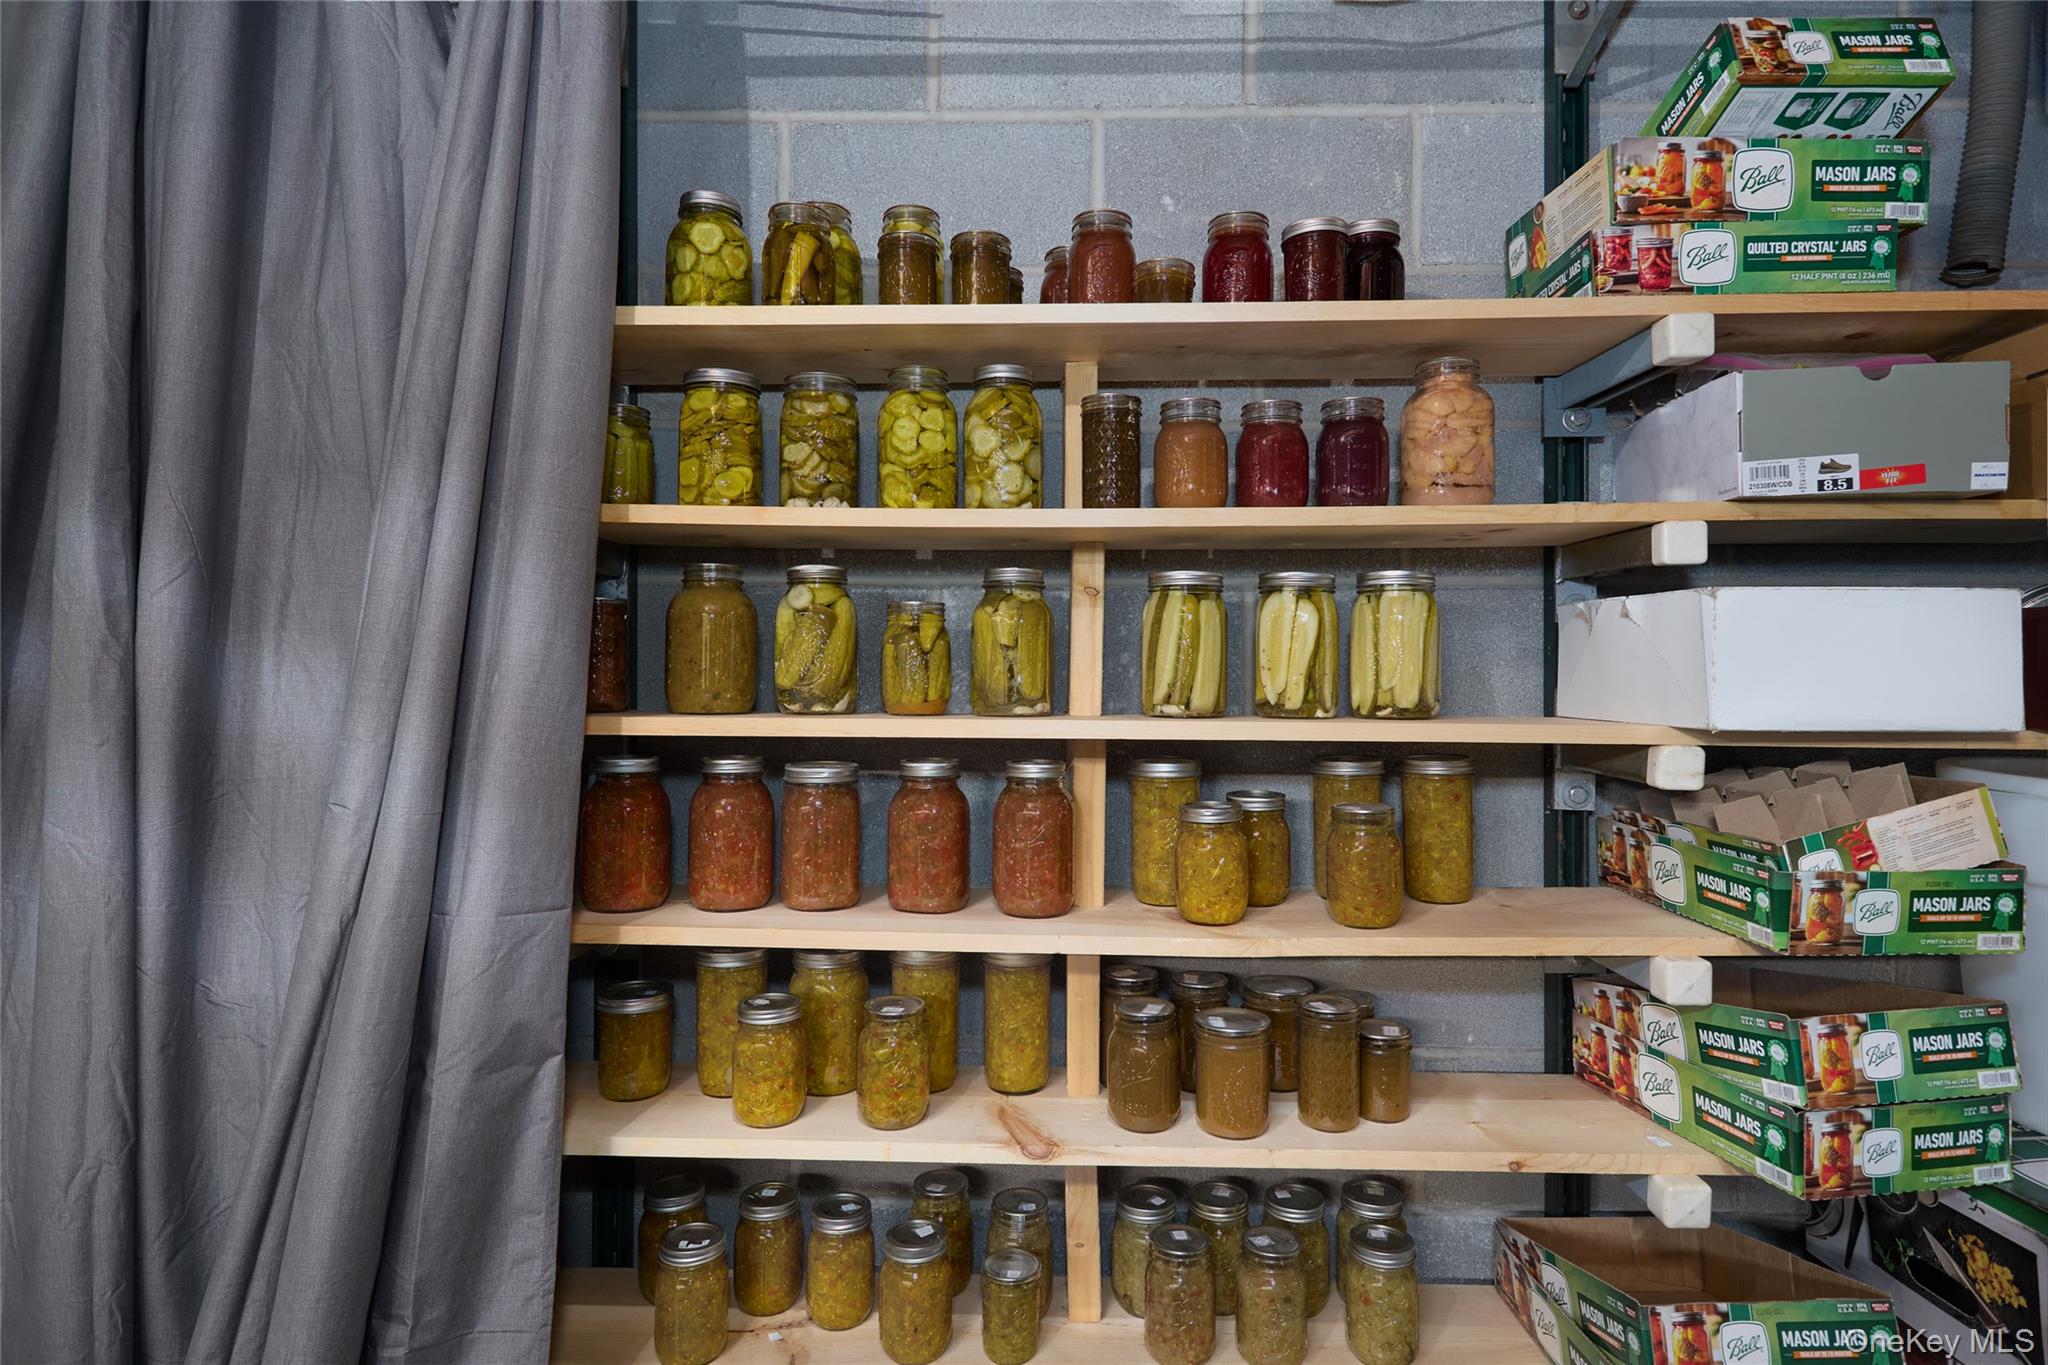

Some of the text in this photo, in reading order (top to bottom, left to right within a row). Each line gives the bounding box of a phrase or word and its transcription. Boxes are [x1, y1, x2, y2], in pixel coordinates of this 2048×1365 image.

[1793, 40, 1824, 55] Ball
[1839, 34, 1913, 46] MASON JARS
[1661, 97, 1686, 135] MASON
[1686, 72, 1705, 101] JARS
[1740, 164, 1786, 194] Ball
[1815, 166, 1896, 182] MASON JARS
[1687, 243, 1730, 271] Ball
[1747, 241, 1788, 255] QUILTED
[1840, 240, 1867, 252] JARS
[1821, 272, 1838, 280] PINT
[1823, 479, 1848, 491] 8.5
[1654, 860, 1681, 885] Ball
[1696, 871, 1727, 894] MASON
[1729, 882, 1752, 902] JARS
[1860, 901, 1894, 923] Ball
[1913, 896, 1991, 912] MASON JARS
[1647, 1020, 1679, 1047] Ball
[1699, 1029, 1765, 1057] MASON JARS
[1912, 1032, 1984, 1052] MASON JARS
[1866, 1042, 1897, 1067] Ball
[1643, 1072, 1675, 1097] Ball
[1695, 1093, 1732, 1126] MASON
[1734, 1112, 1762, 1138] JARS
[1914, 1128, 1984, 1149] MASON JARS
[1867, 1139, 1898, 1164] Ball
[1579, 1300, 1606, 1329] MASON
[1606, 1317, 1625, 1343] JARS
[1727, 1335, 1764, 1361] Ball
[1781, 1330, 1829, 1348] MASON
